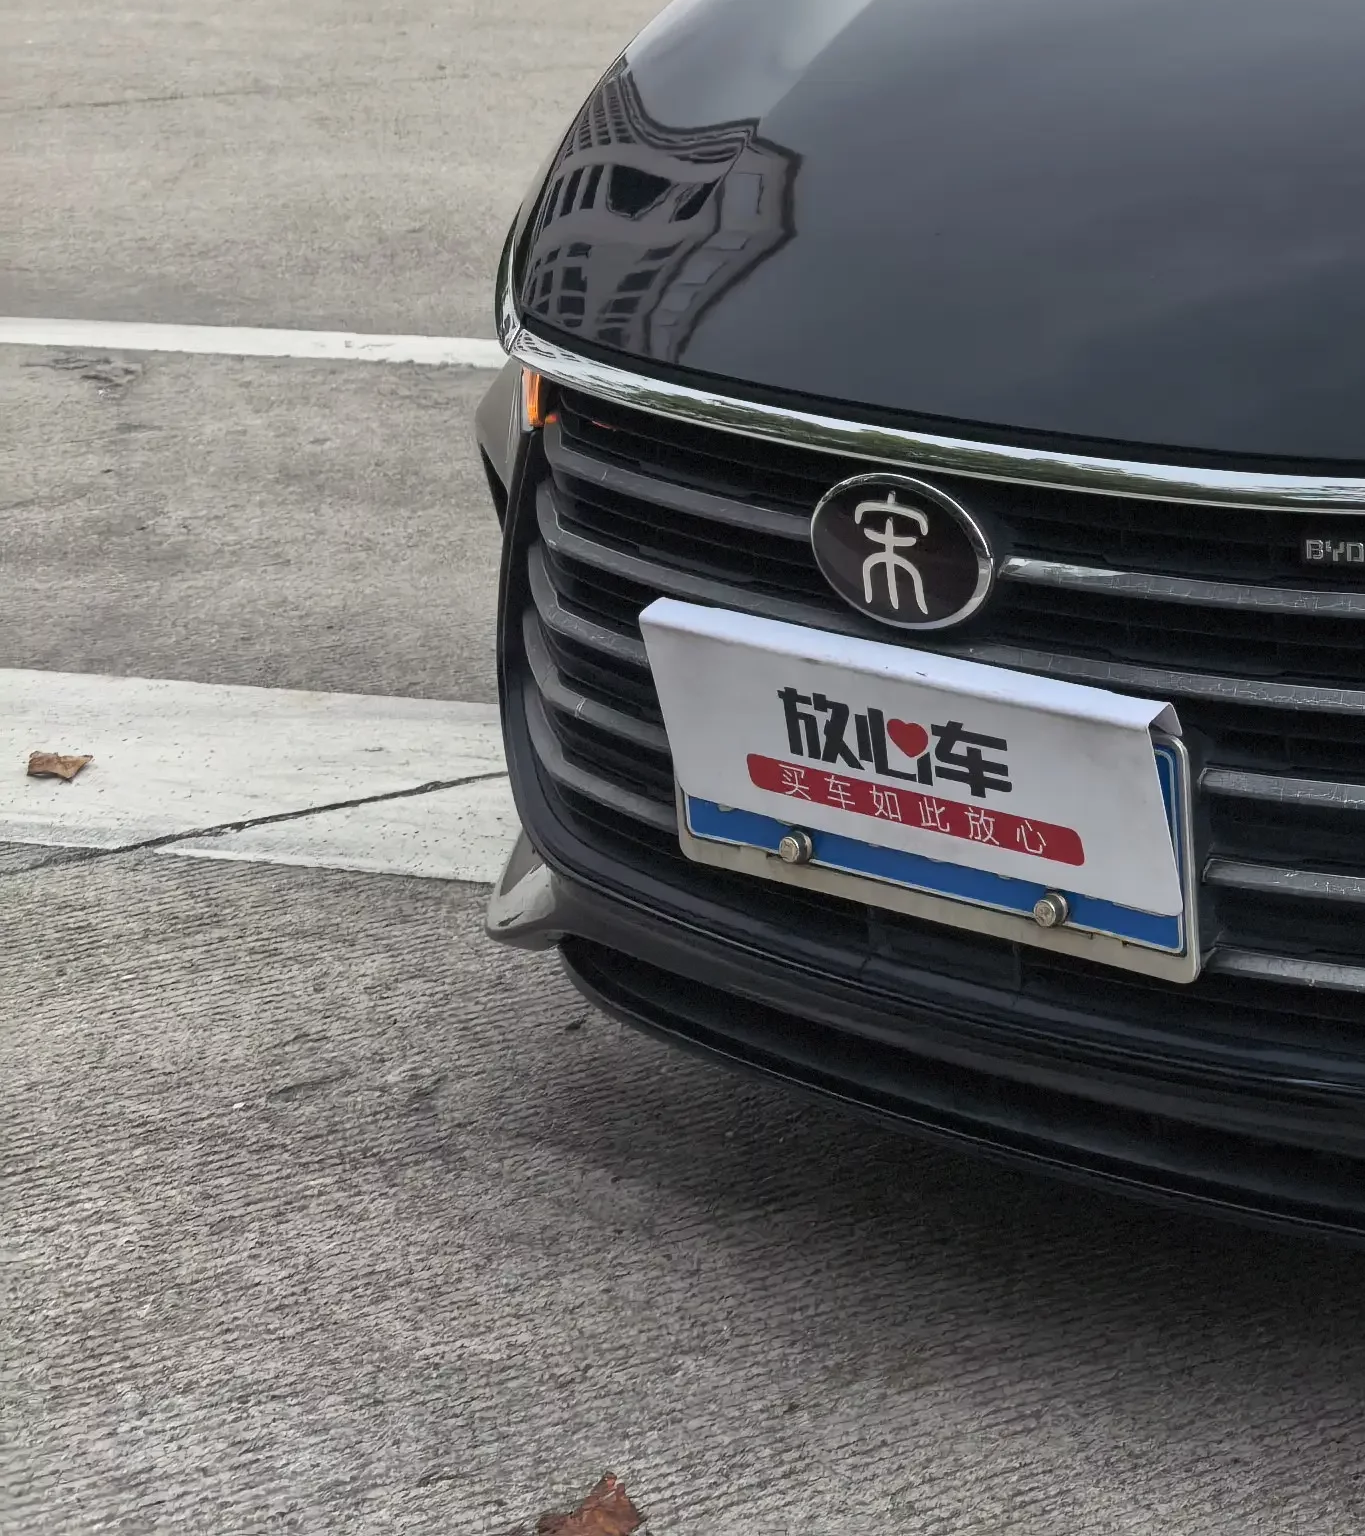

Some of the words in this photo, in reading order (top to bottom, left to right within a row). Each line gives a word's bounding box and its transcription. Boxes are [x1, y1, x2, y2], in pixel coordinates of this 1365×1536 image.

[1306, 539, 1365, 562] BYD
[777, 686, 1013, 798] 放心车
[777, 763, 1047, 855] 买车如此放心
